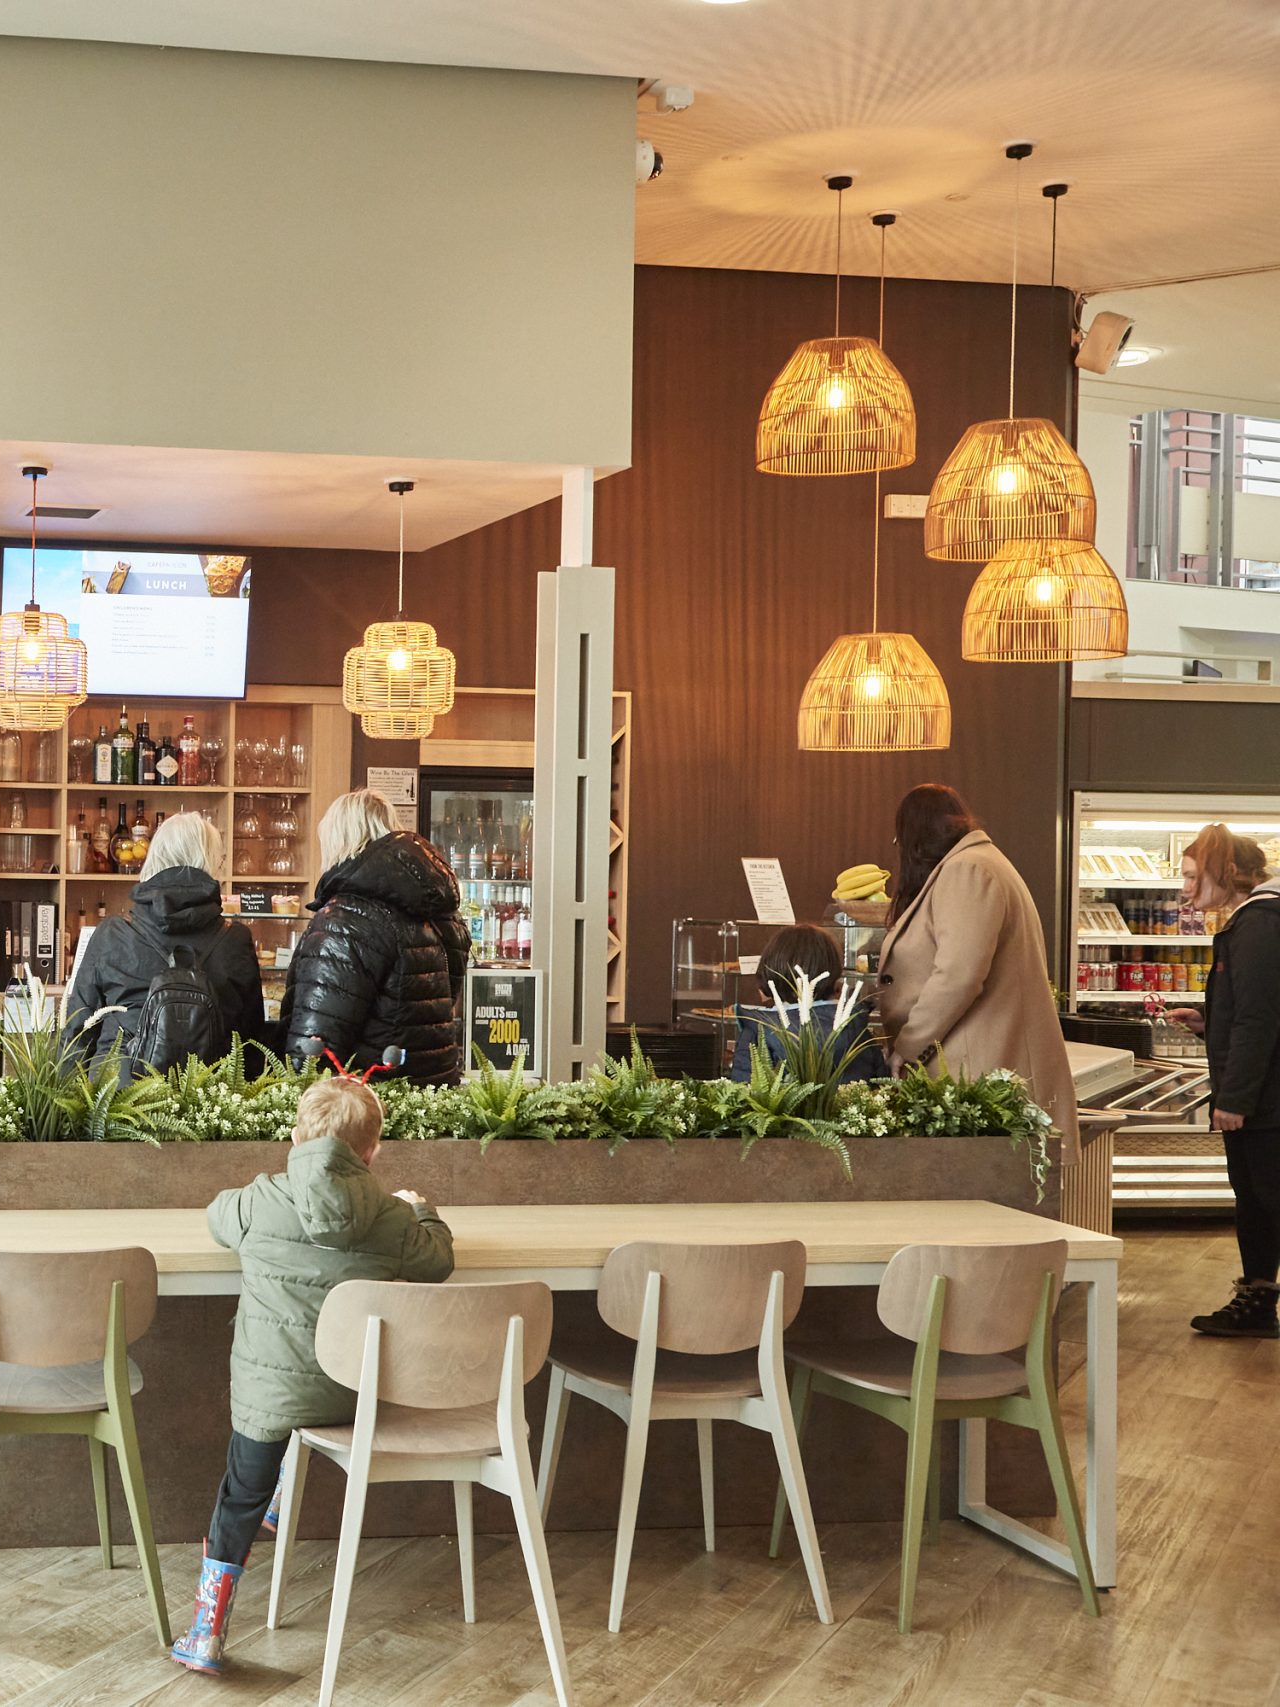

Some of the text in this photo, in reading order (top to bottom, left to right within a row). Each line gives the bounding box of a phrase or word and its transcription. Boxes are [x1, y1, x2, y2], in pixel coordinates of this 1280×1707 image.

[146, 579, 187, 590] LUNCH
[475, 1006, 505, 1018] ADULTS
[489, 1019, 520, 1043] 2000
[506, 1044, 530, 1056] A DAY!
